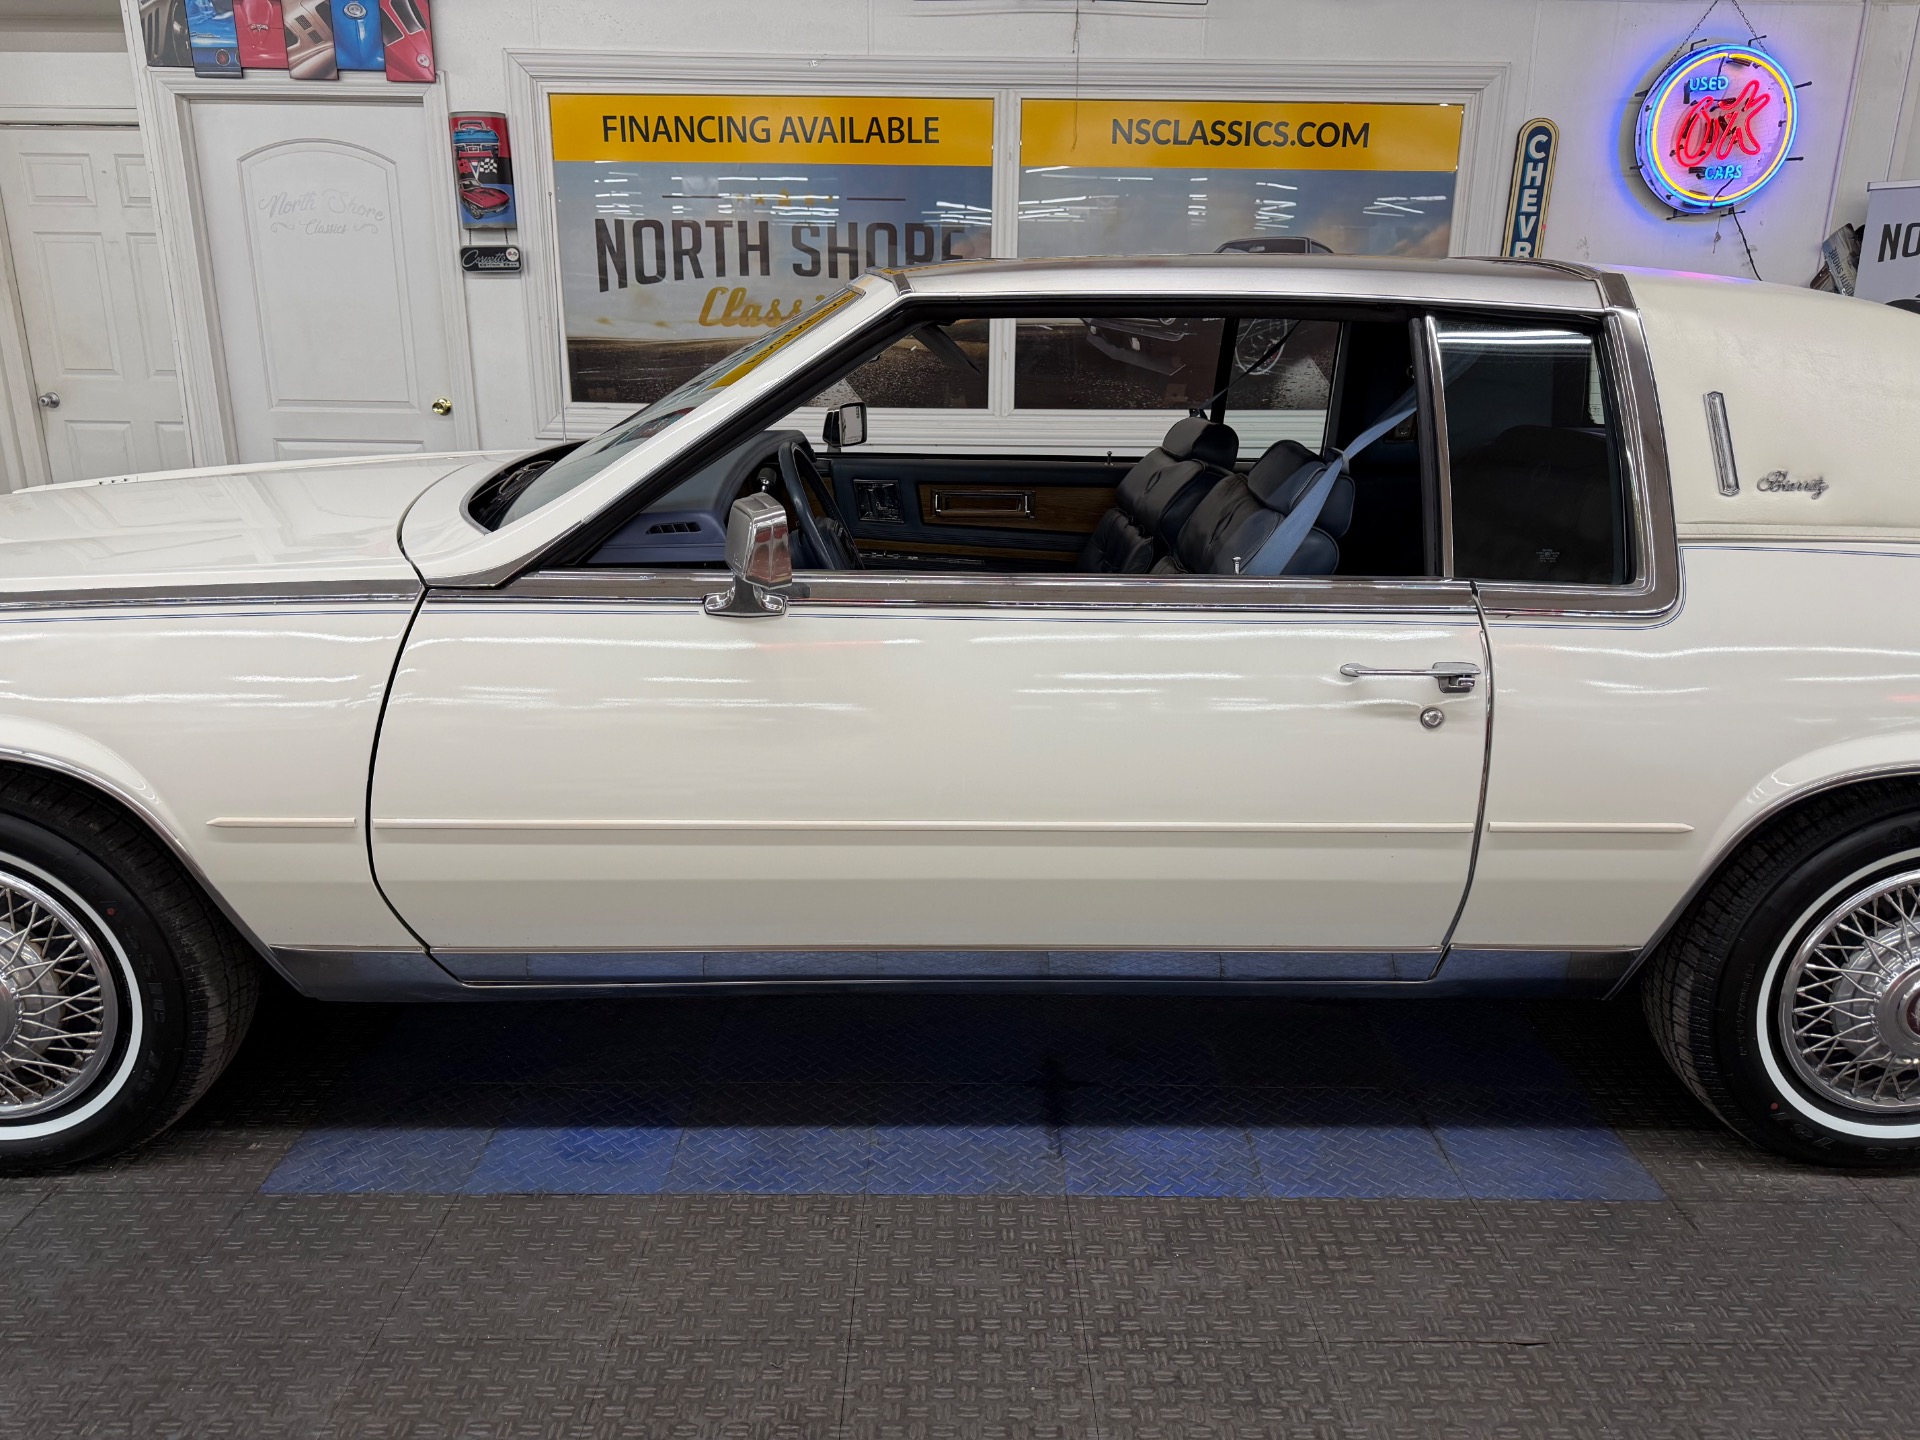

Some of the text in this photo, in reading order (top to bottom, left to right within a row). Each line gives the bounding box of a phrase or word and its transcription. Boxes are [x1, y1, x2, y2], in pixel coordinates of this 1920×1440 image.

[1689, 76, 1729, 91] USED
[602, 115, 940, 145] FINANCING AVAILABLE
[1111, 118, 1370, 148] NSCLASSICS.COM
[1675, 80, 1770, 168] OK
[1704, 165, 1743, 180] CARS
[258, 188, 385, 222] North Shore
[299, 218, 348, 236] Classics
[462, 249, 509, 268] Corvette
[595, 218, 771, 293] NORTH
